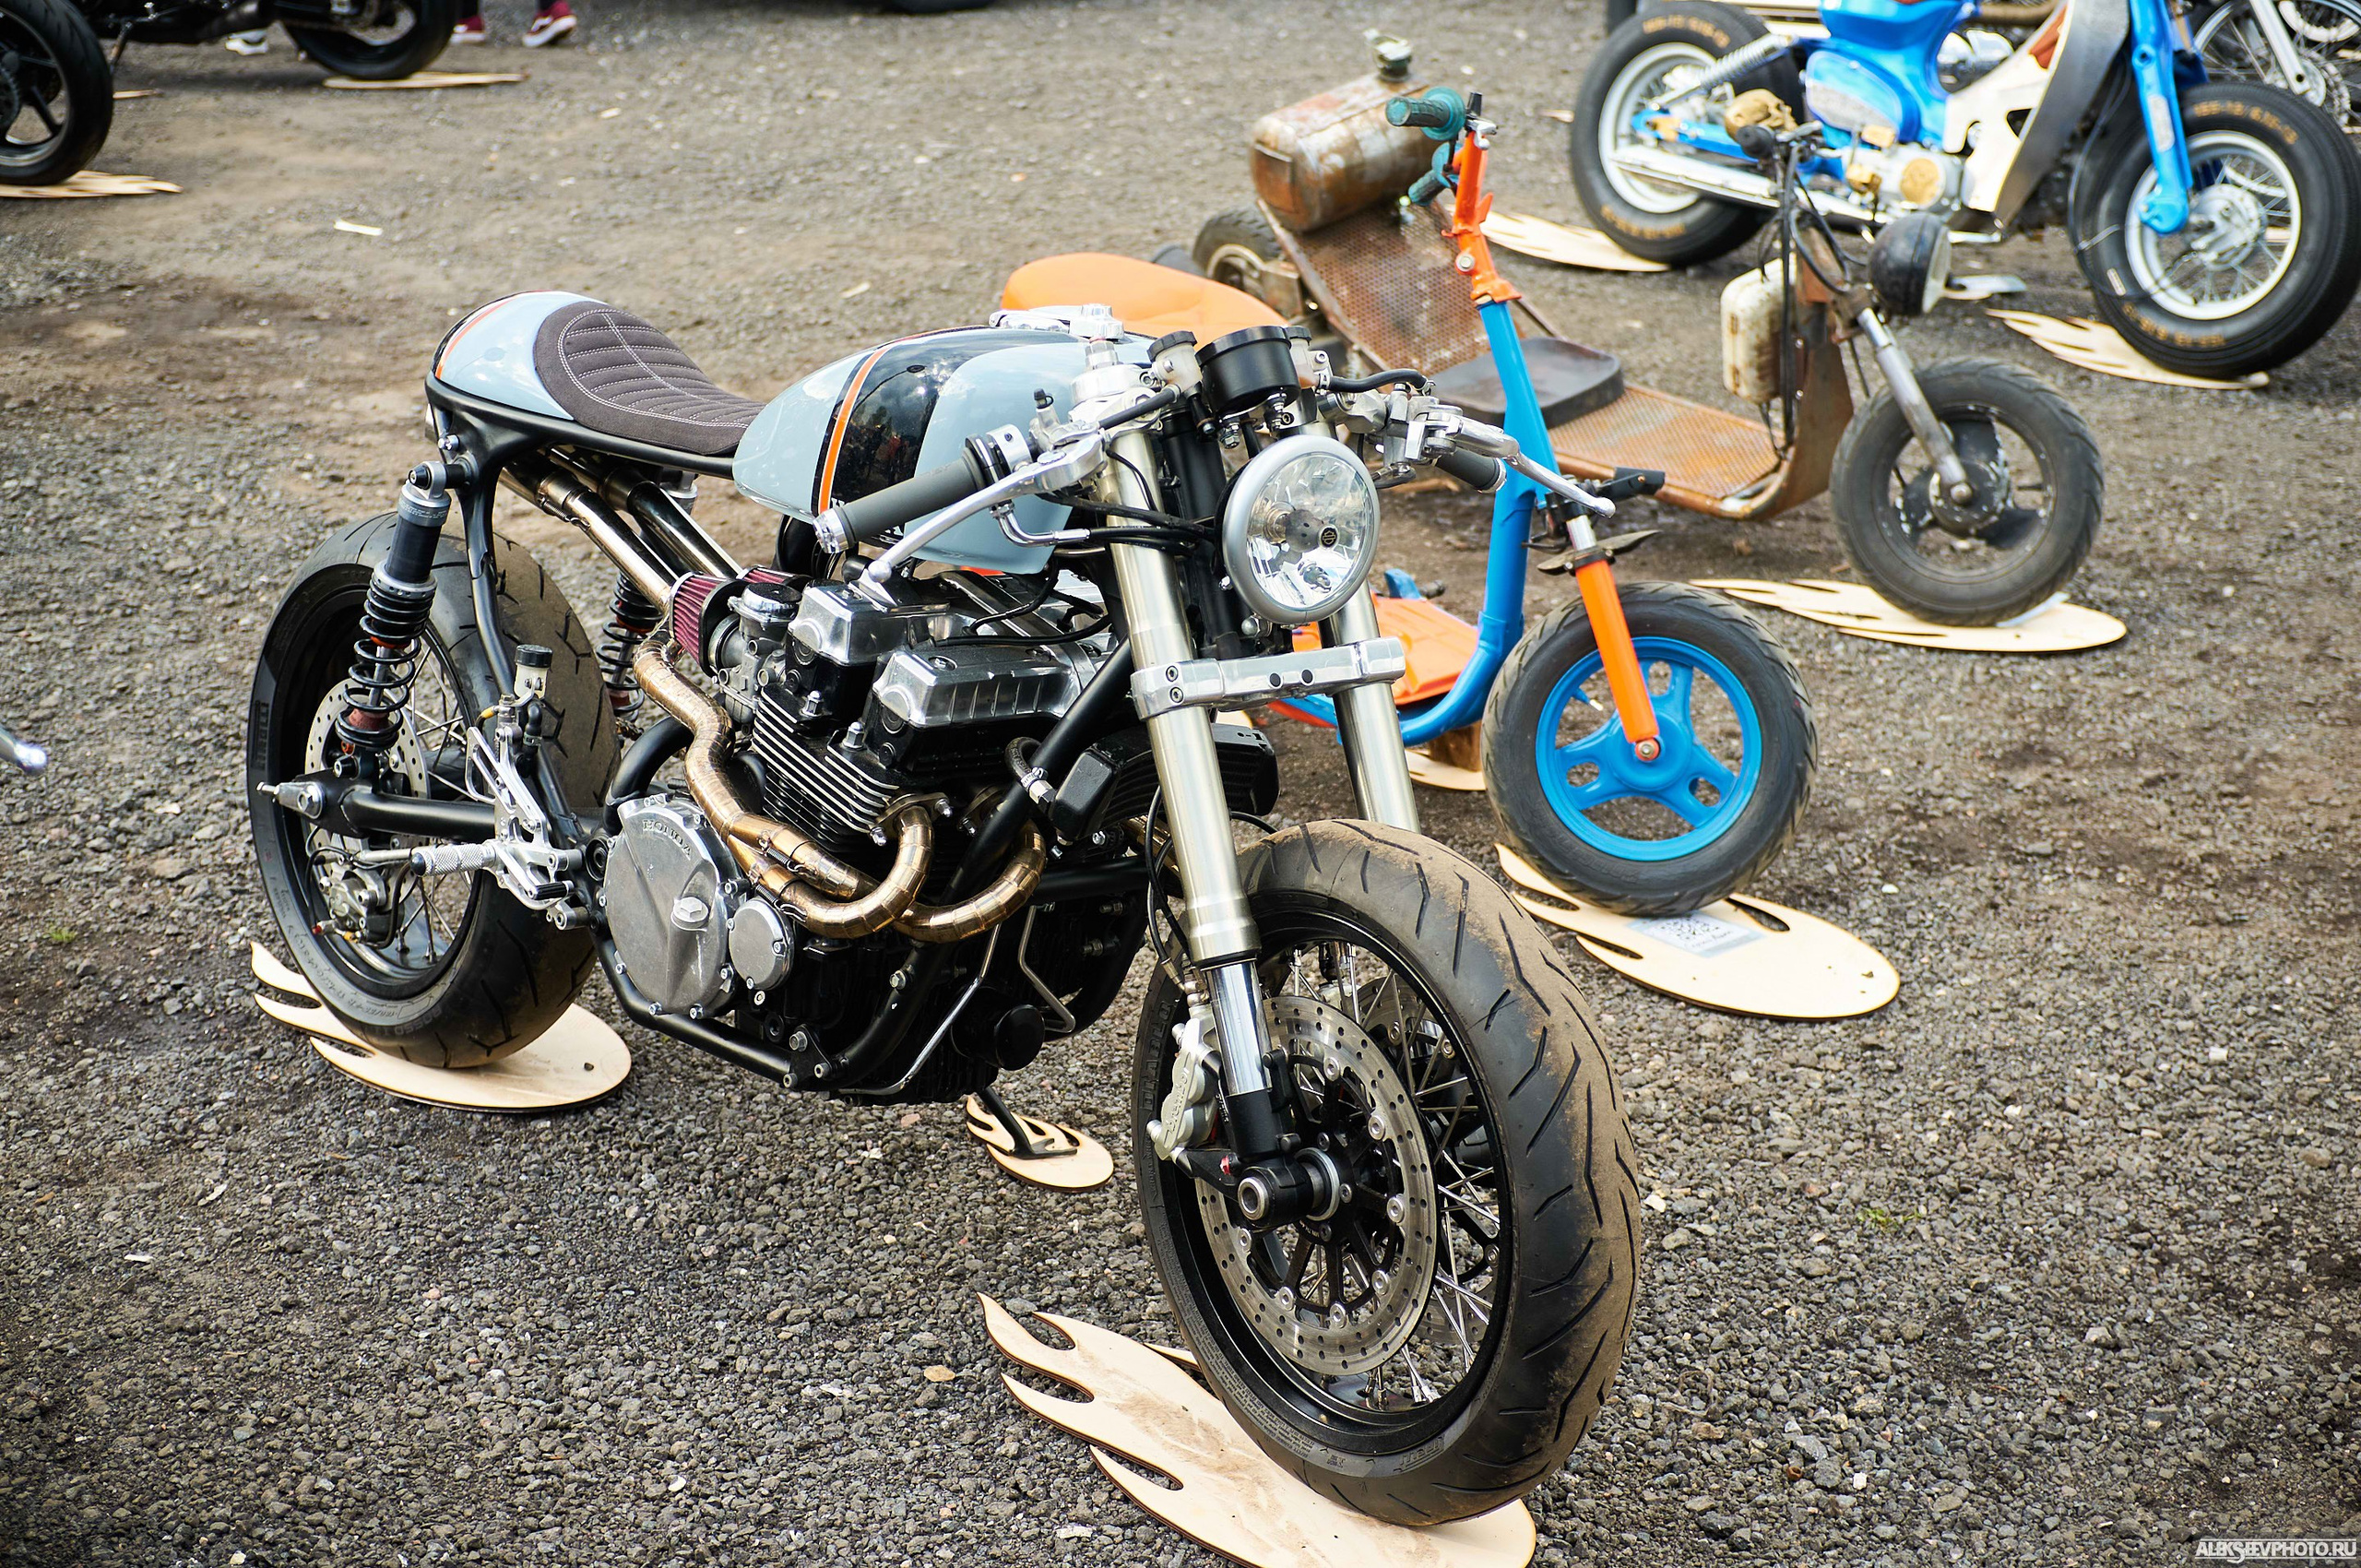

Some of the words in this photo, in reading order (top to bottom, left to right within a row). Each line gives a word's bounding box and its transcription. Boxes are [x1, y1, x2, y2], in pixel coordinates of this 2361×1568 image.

[642, 818, 692, 861] HONDA
[394, 1005, 443, 1037] ROSSO
[1142, 1000, 1172, 1111] DIABLO
[1166, 1071, 1189, 1134] brembo
[1398, 1435, 1445, 1469] PIRELLI
